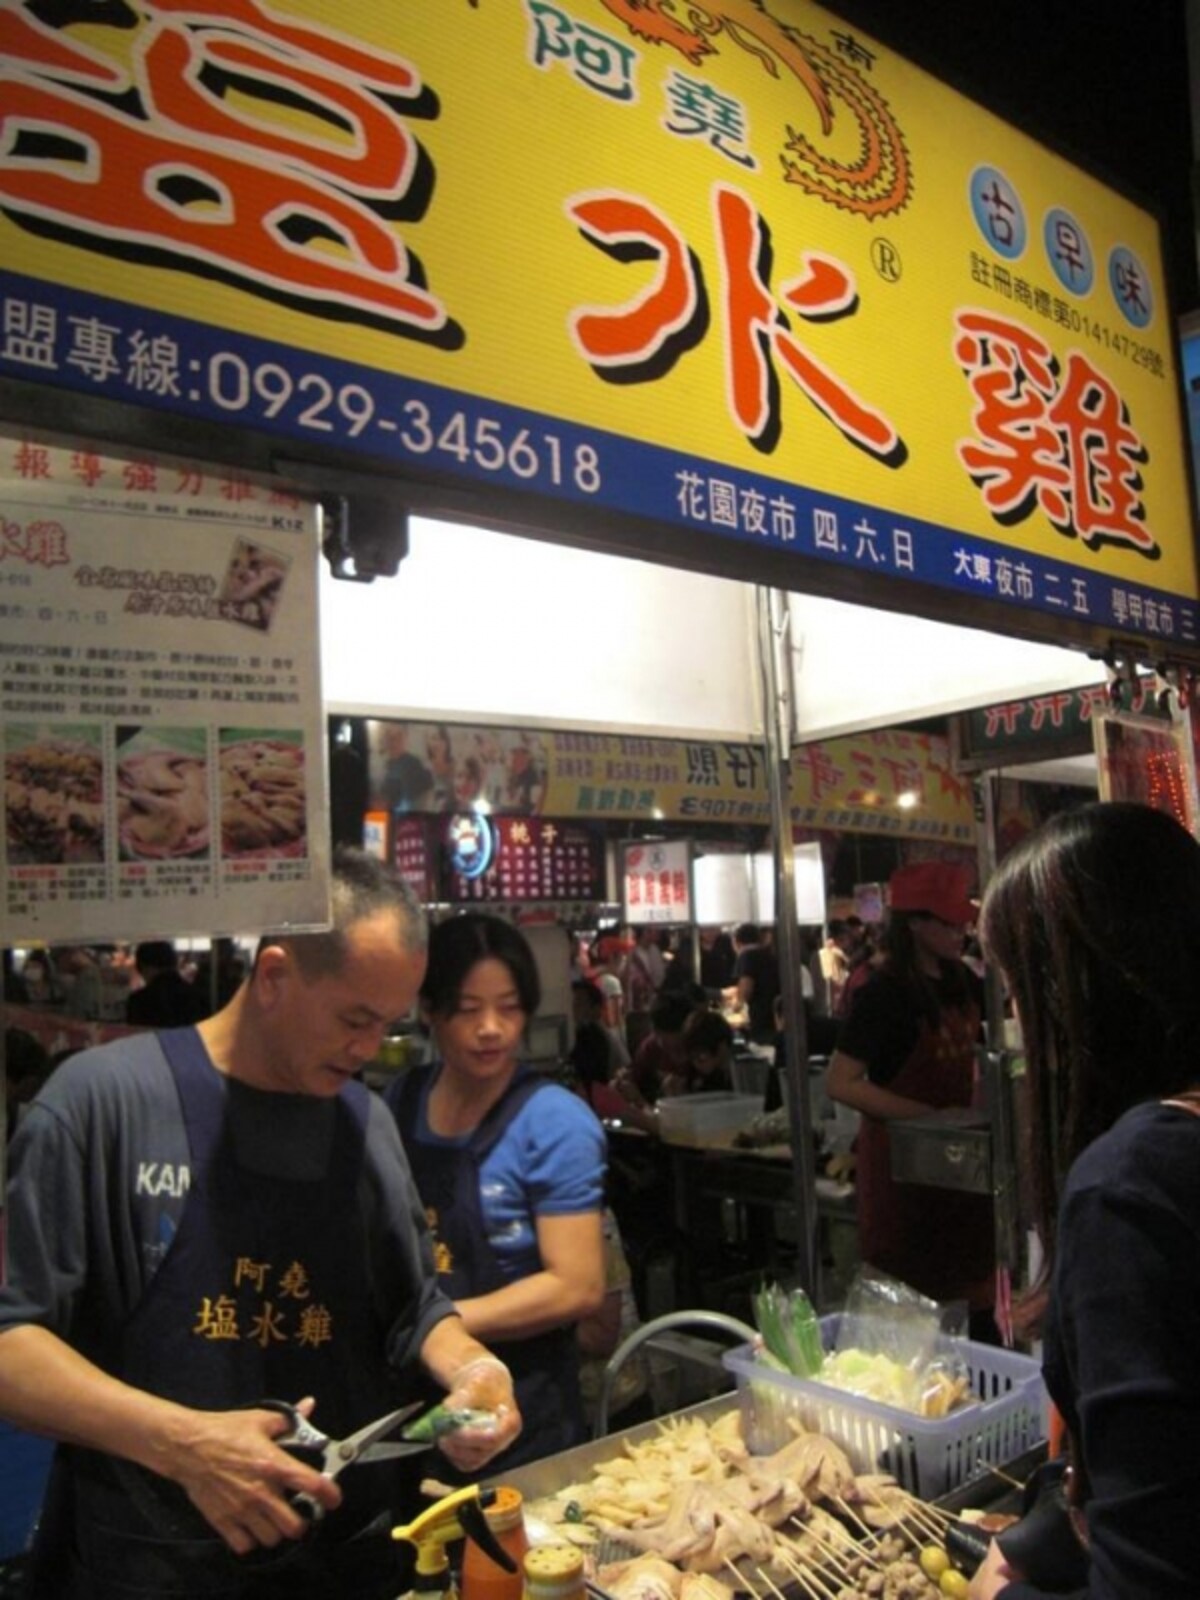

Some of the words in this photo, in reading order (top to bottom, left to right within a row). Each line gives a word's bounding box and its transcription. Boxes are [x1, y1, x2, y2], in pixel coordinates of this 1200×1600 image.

[980, 180, 1149, 315] 古早味
[675, 469, 797, 543] 花園夜市
[953, 547, 1034, 600] 大東夜市
